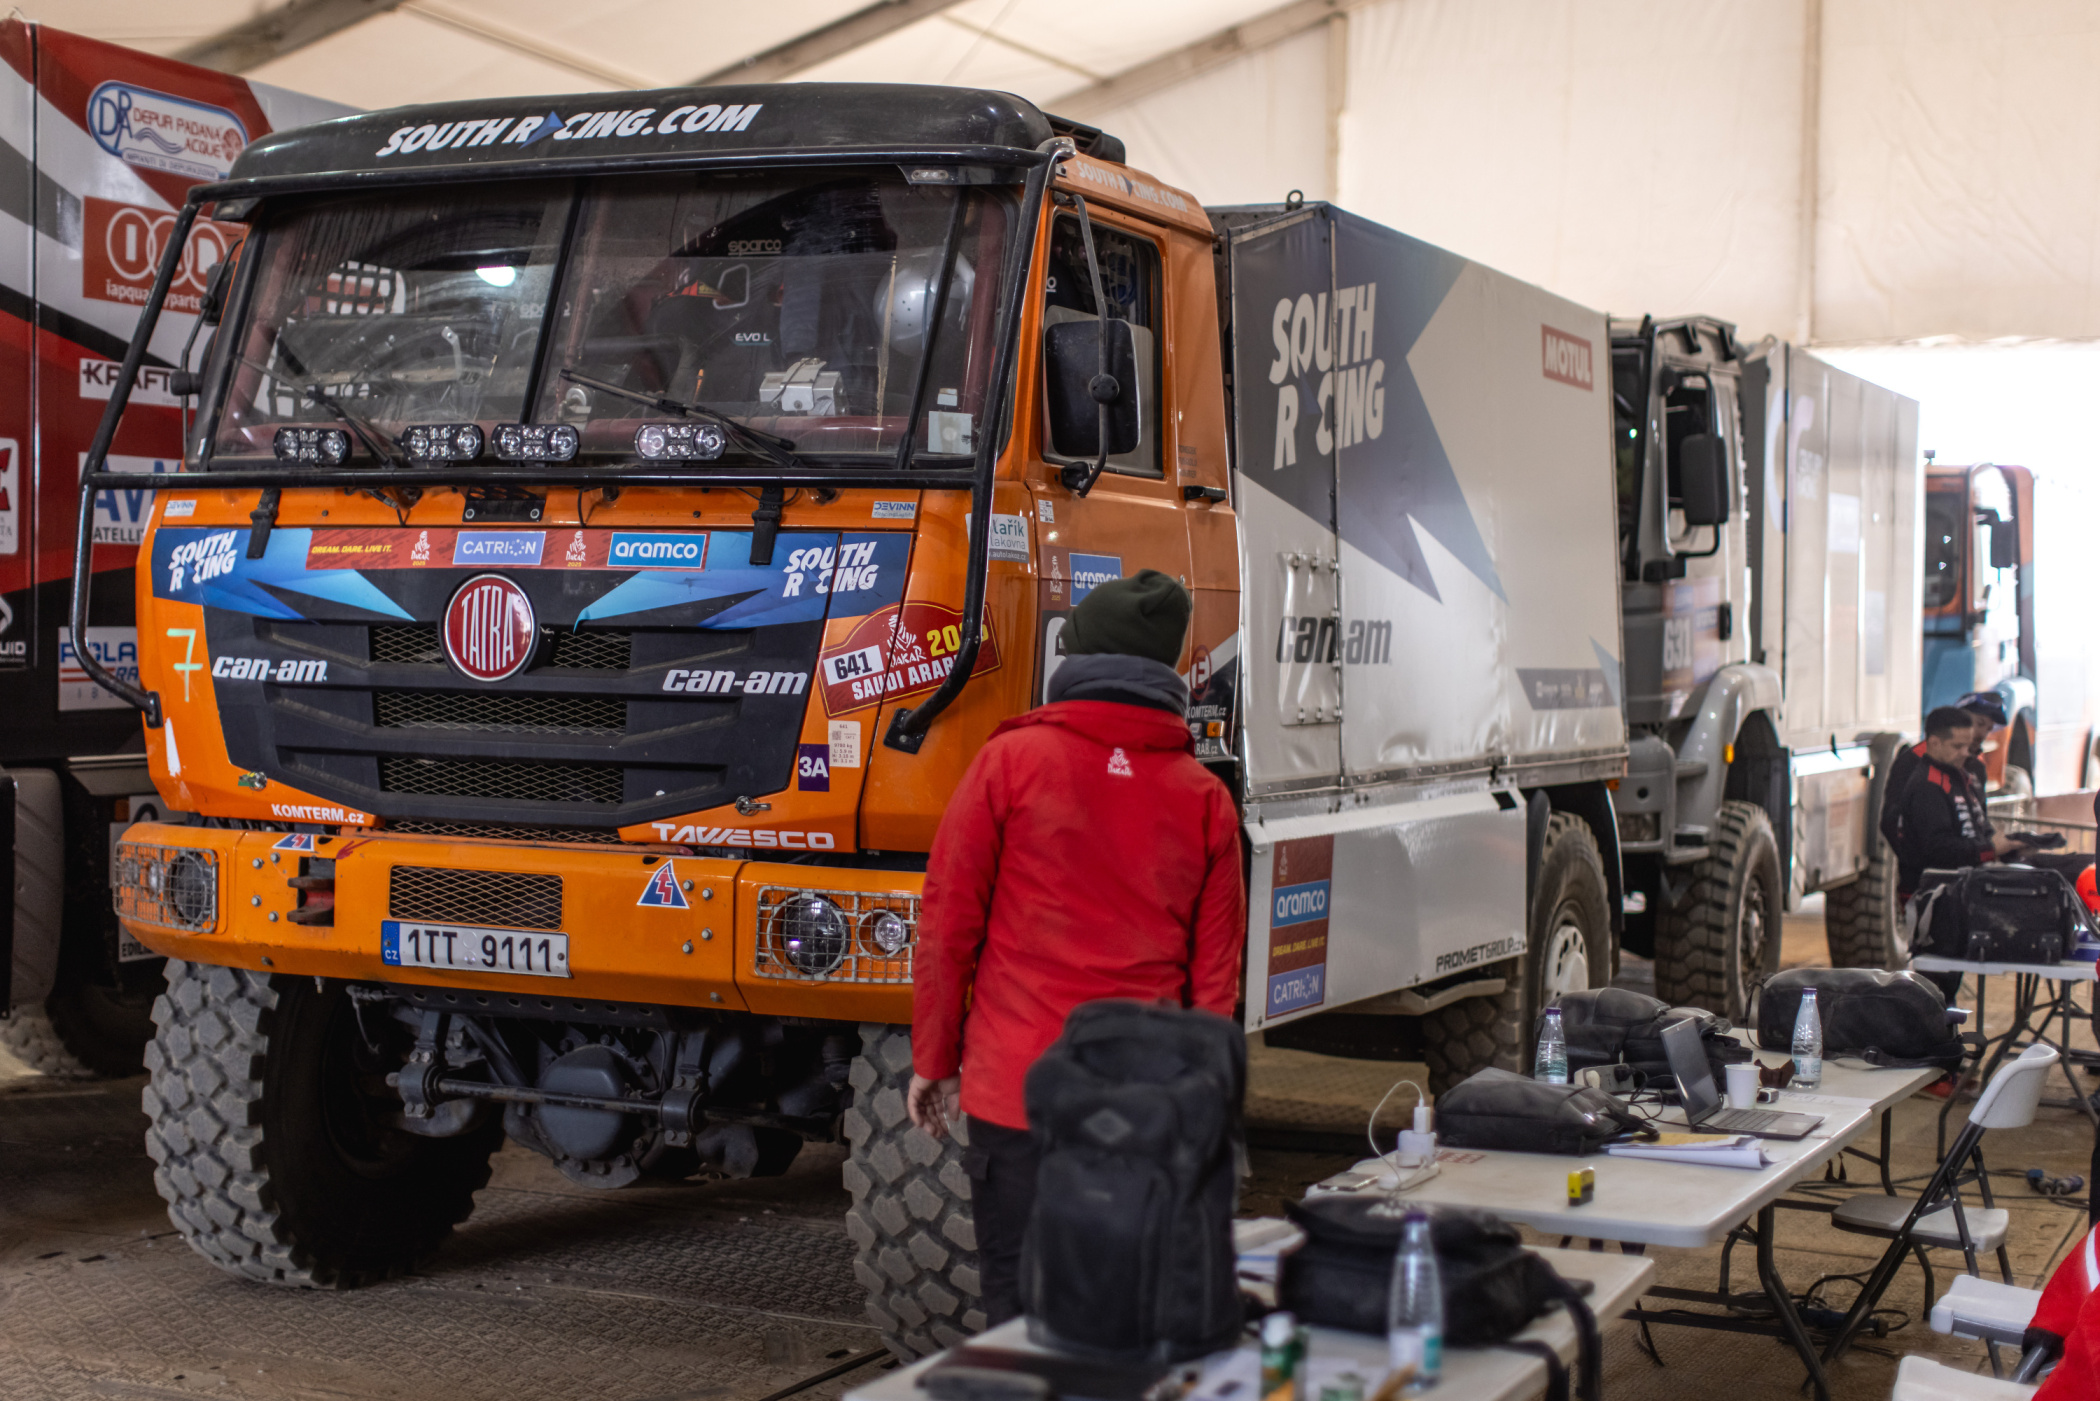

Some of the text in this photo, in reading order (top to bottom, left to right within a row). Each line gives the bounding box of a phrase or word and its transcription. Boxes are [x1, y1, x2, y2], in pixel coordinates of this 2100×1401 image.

[133, 107, 220, 141] DEPUR PADANA
[376, 118, 516, 157] SOUTH
[184, 138, 221, 158] ACQUE
[1076, 160, 1119, 191] SOUTH
[735, 332, 760, 342] EVO
[1268, 283, 1376, 385] SOUTH
[1545, 334, 1592, 384] MOTUL
[168, 530, 238, 560] SOUTH
[365, 545, 382, 553] LIVE
[615, 542, 698, 559] aramco
[783, 541, 878, 573] SOUTH
[461, 585, 515, 671] TATRA
[926, 616, 989, 657] 20
[212, 656, 327, 682] can-am
[834, 651, 872, 680] 641
[886, 645, 926, 668] DAKAR
[662, 669, 808, 694] can-am
[852, 672, 904, 700] SAUDI
[799, 756, 829, 778] 3A
[271, 803, 364, 824] KOMTERM.cz
[651, 823, 835, 849] TAWESCO
[1276, 889, 1325, 918] aramco
[385, 949, 399, 960] CZ
[407, 929, 552, 973] 1TT 9111
